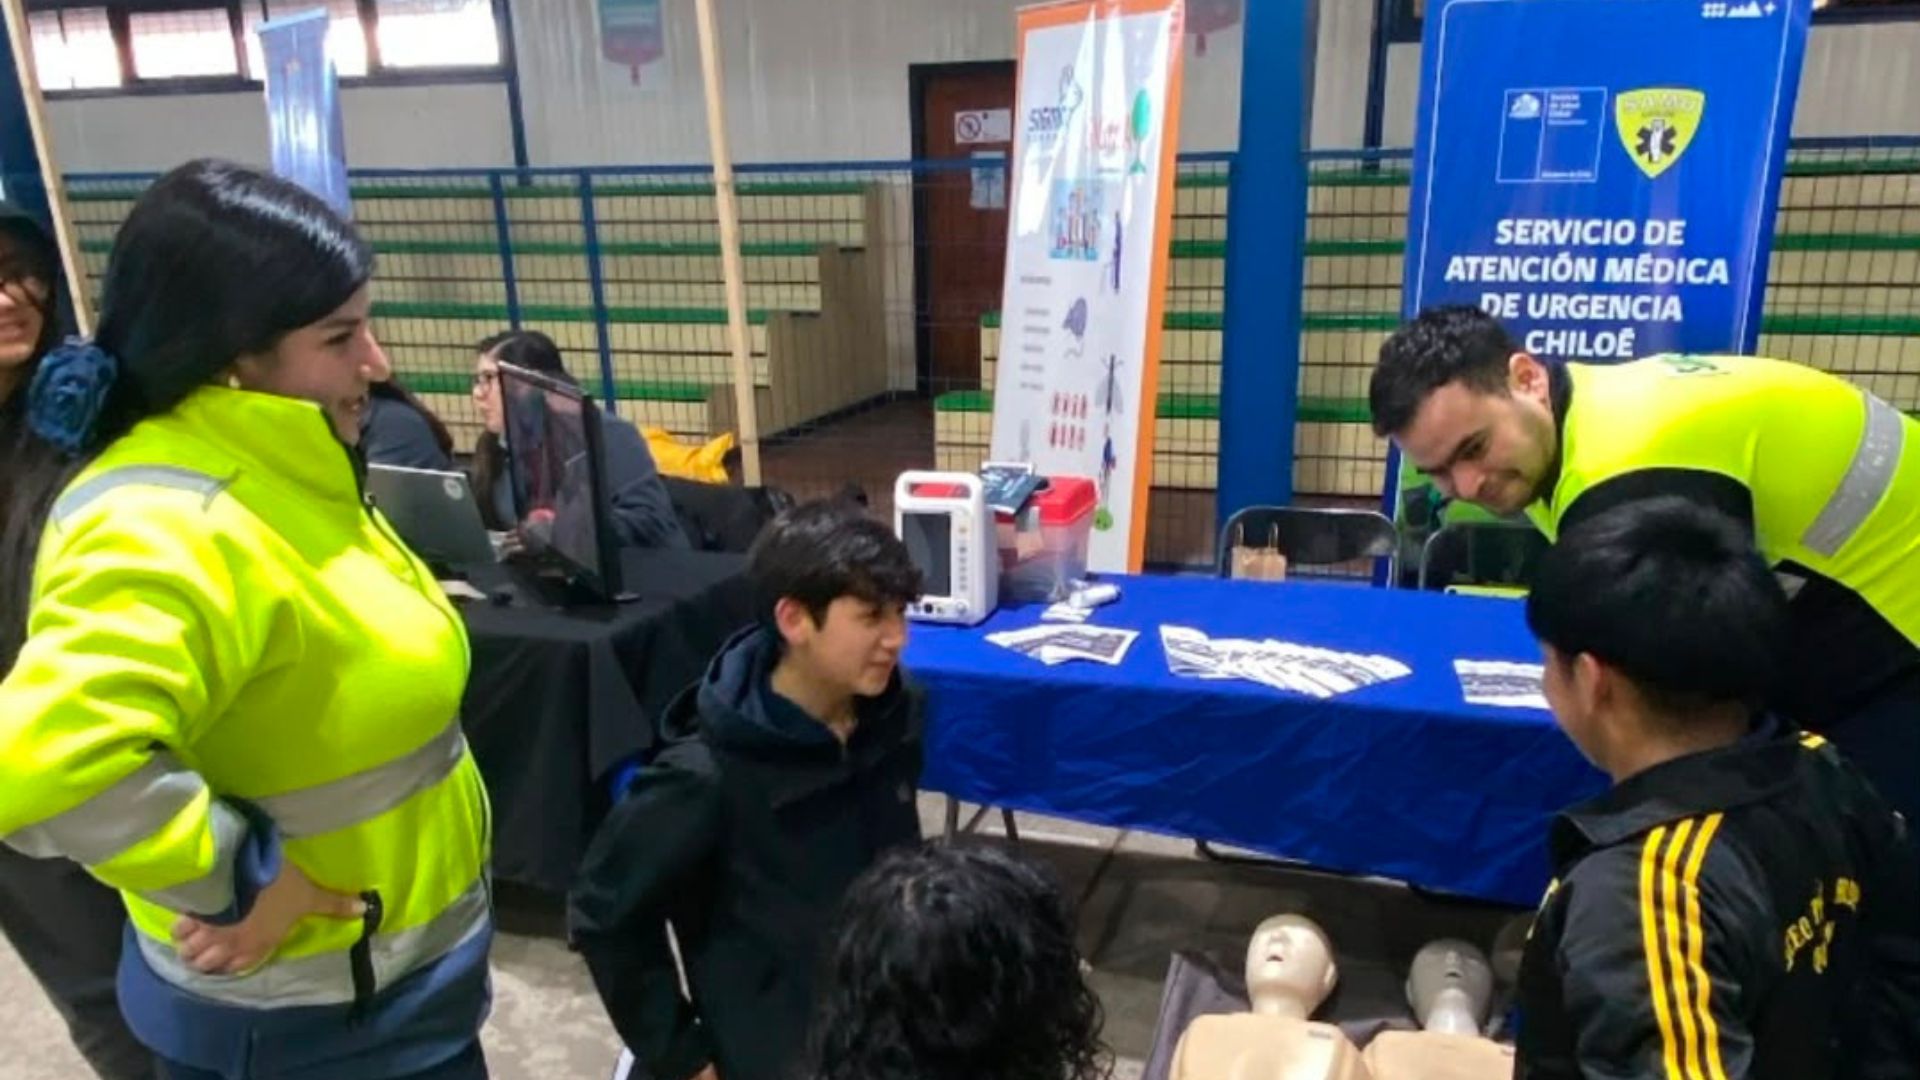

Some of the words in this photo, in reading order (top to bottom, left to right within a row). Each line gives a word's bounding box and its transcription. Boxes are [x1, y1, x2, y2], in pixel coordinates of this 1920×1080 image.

[1495, 218, 1636, 246] SERVICIO
[1643, 219, 1686, 246] DE
[1444, 252, 1597, 284] ATENCIÓN
[1603, 253, 1729, 285] MÉDICA
[1480, 292, 1521, 318] DE
[1527, 293, 1683, 322] URGENCIA
[1525, 327, 1636, 357] CHILOÉ
